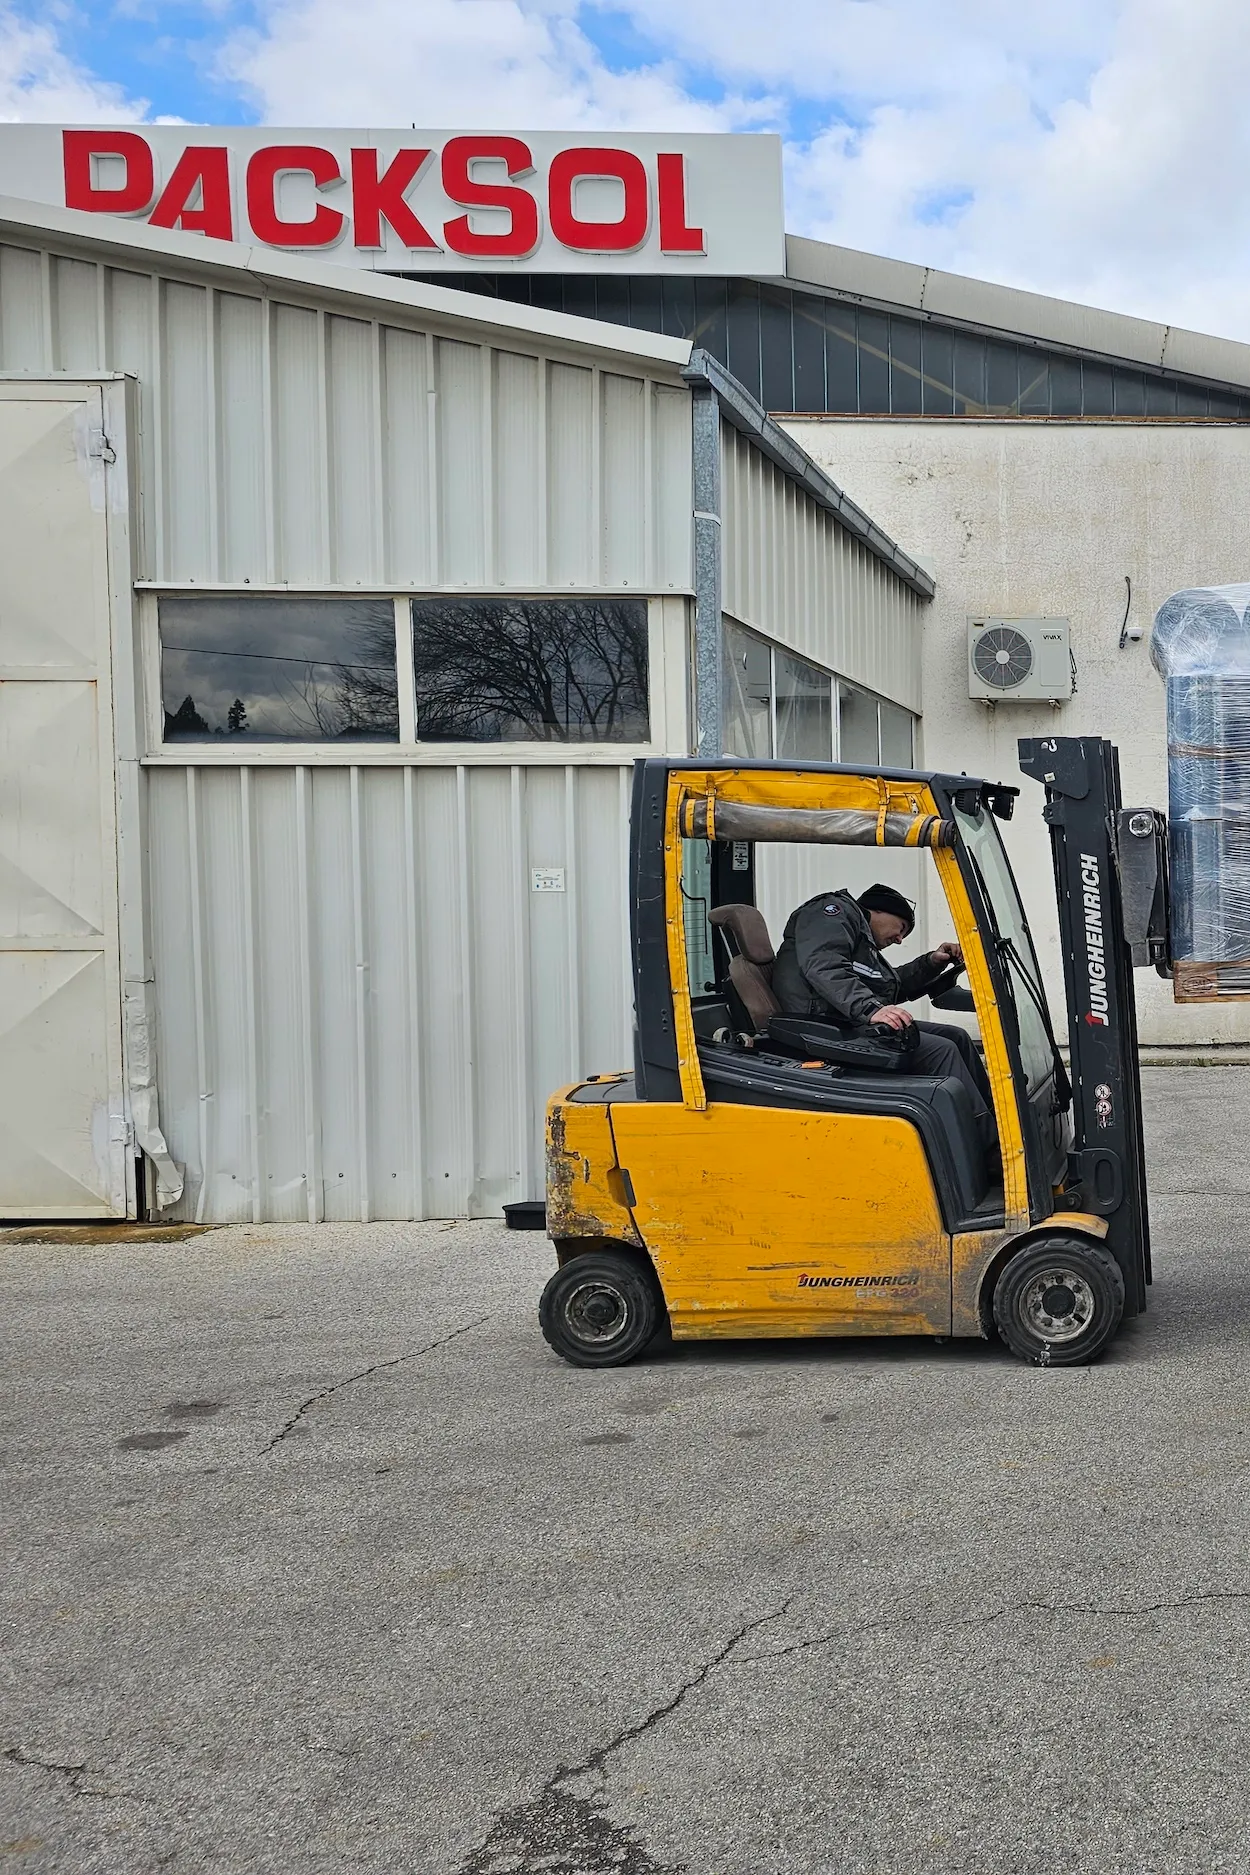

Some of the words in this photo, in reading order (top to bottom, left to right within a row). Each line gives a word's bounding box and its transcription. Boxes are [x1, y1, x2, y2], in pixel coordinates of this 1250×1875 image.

[1079, 853, 1109, 1027] JUNGHEINRICH
[798, 1275, 920, 1287] JUNGHEINRICH
[856, 1288, 887, 1298] EFG
